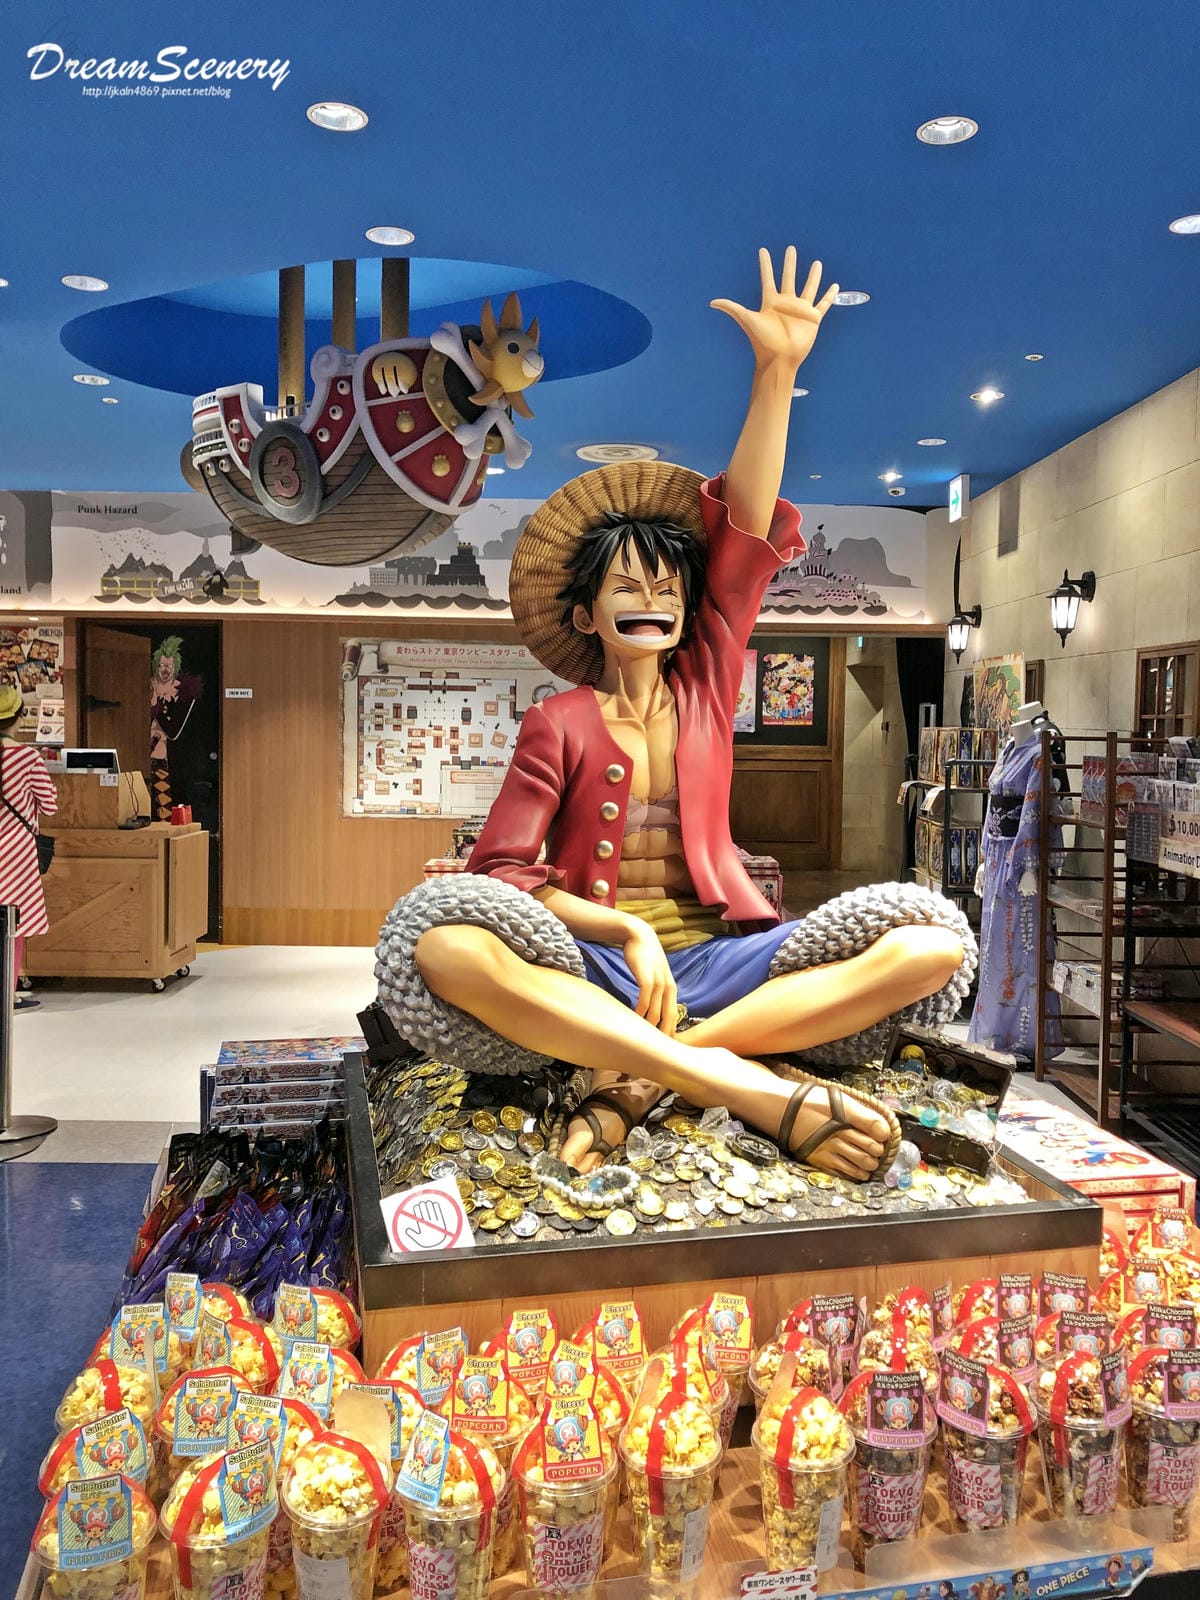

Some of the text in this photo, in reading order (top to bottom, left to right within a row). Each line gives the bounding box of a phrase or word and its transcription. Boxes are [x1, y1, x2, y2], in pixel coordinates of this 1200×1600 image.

[272, 449, 300, 498] 3
[77, 505, 138, 514] Punk Hazard
[555, 1399, 585, 1410] Cheese
[457, 1421, 502, 1430] POPCORN
[552, 1466, 599, 1478] POPCORN
[872, 1486, 914, 1498] TOKYO
[548, 1534, 593, 1551] TOKYO
[1036, 1566, 1090, 1596] ONE PIECE
